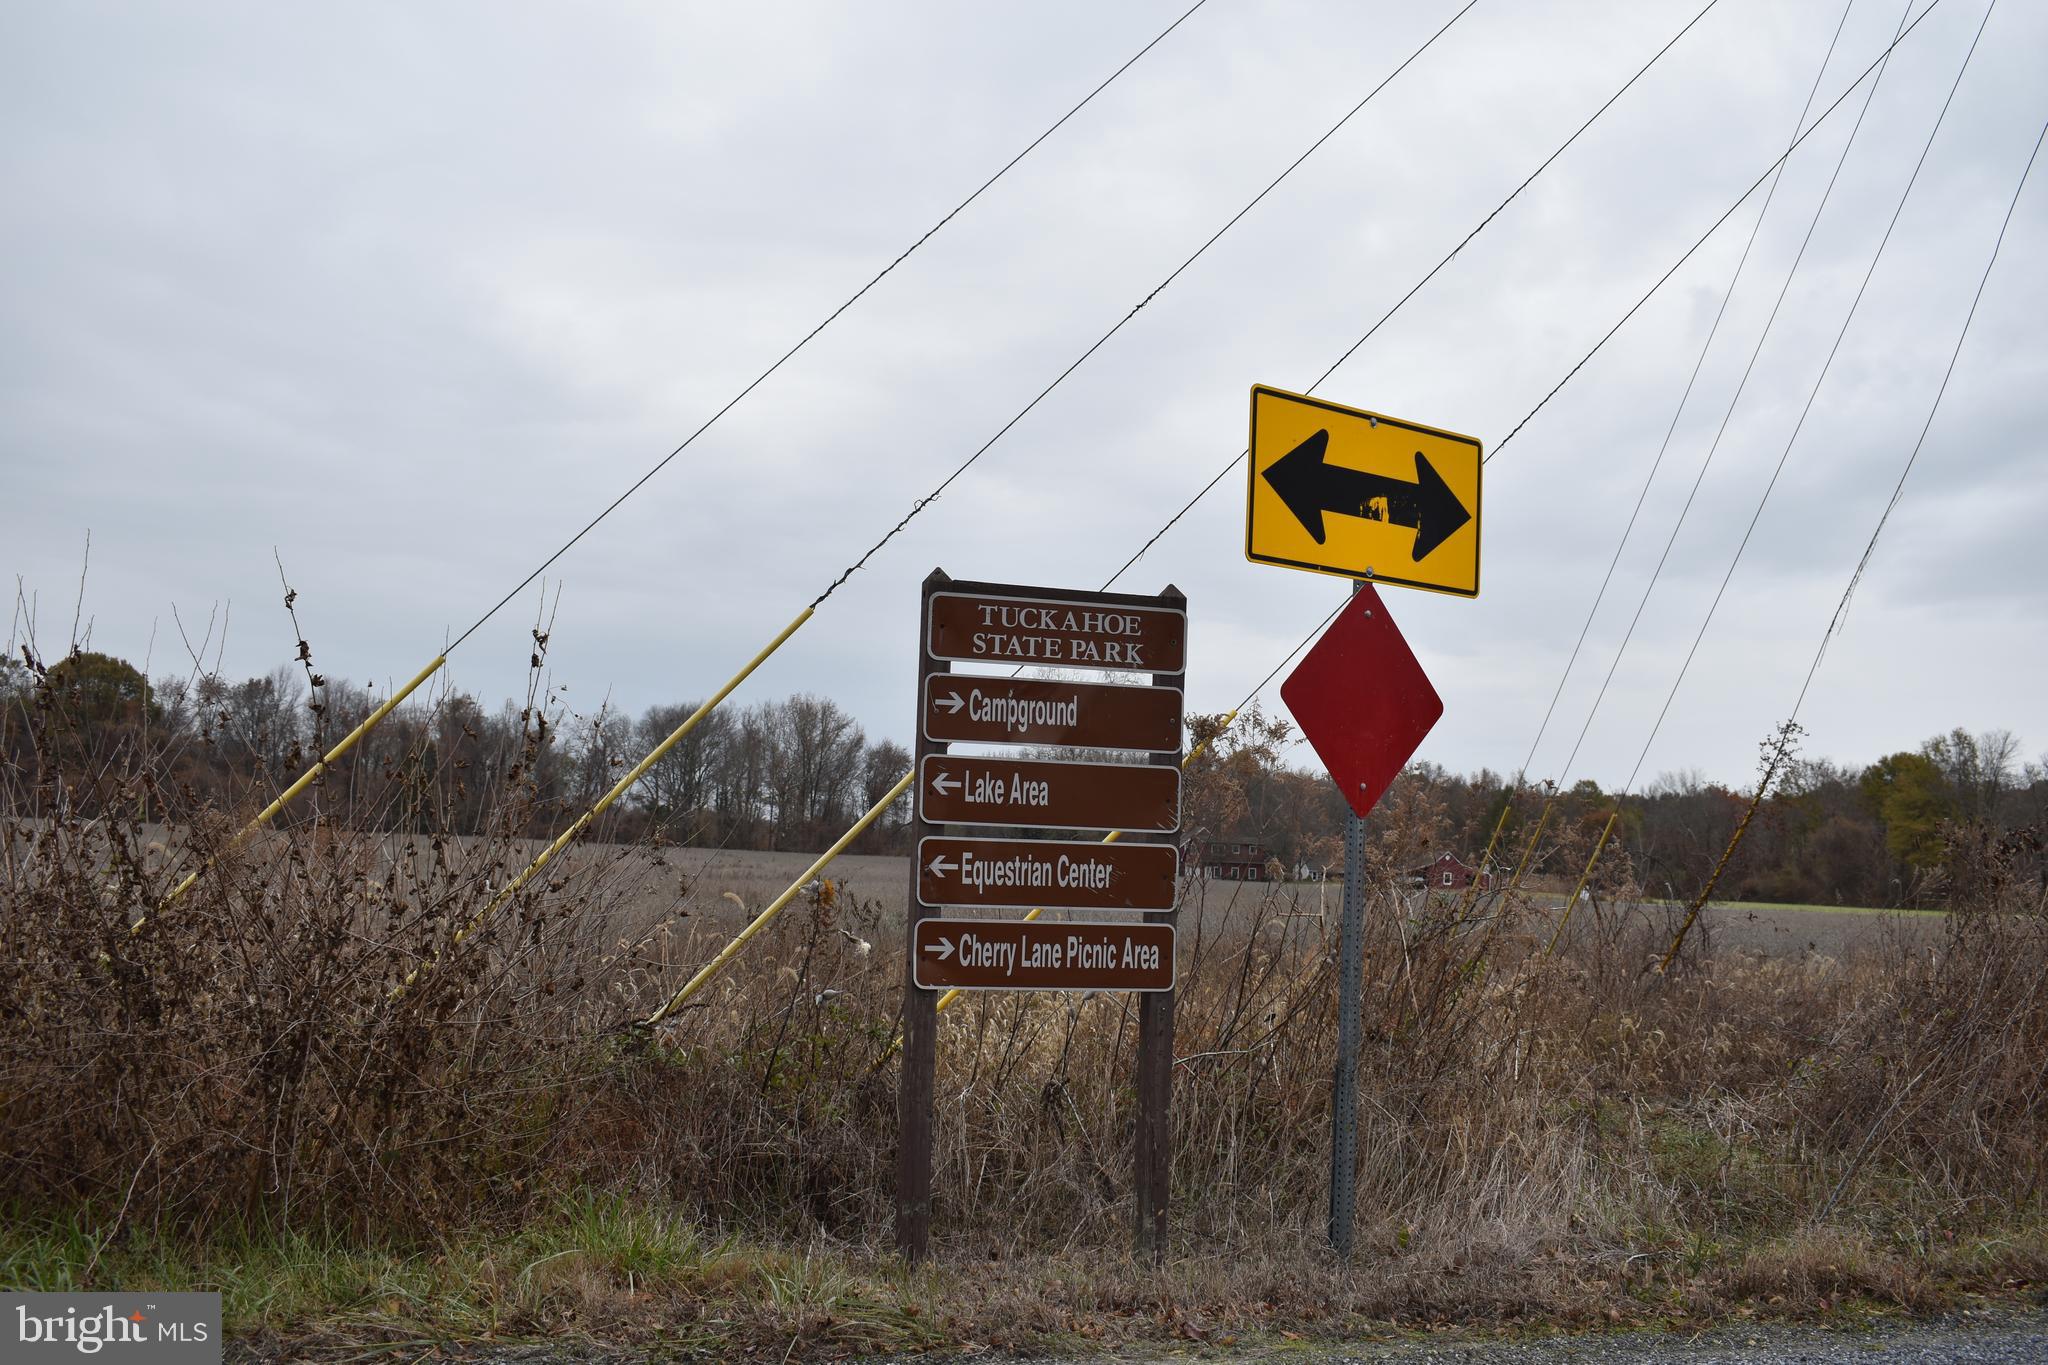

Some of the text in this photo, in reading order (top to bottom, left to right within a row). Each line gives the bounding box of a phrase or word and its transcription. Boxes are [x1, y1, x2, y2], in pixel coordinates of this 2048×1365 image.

[978, 604, 1142, 636] TUCKAHOE
[972, 632, 1144, 665] STATE PARK
[969, 688, 1077, 732] Campground
[964, 770, 1049, 806] Lake Area
[961, 852, 1113, 894] Equestrian Center
[959, 933, 1159, 976] Cherry Lane Picnic Area
